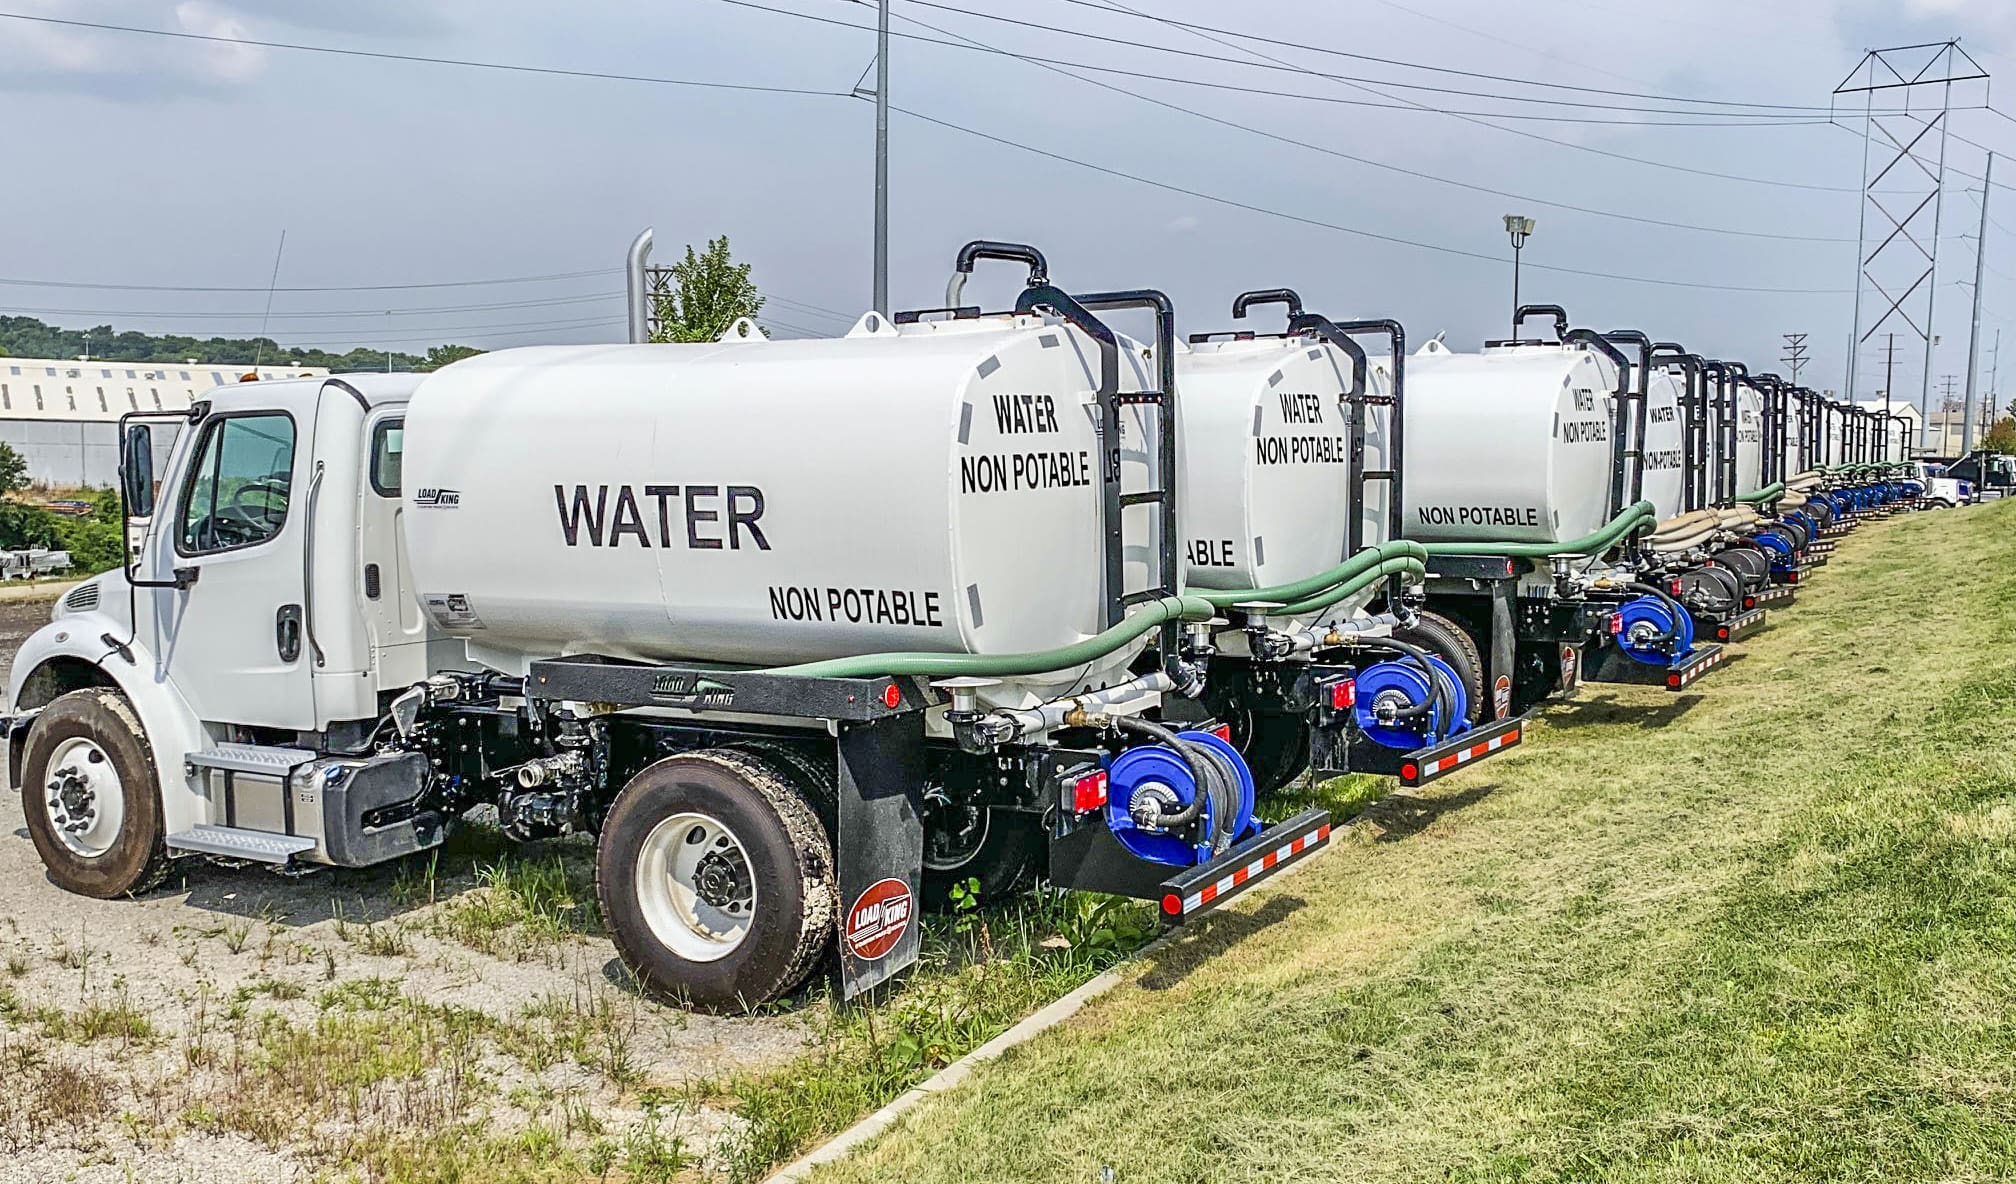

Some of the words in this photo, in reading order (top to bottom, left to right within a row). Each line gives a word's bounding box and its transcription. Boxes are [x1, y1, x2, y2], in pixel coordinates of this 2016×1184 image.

[993, 395, 1059, 434] WATER
[1280, 393, 1323, 424] WATER
[1572, 388, 1595, 412] WATER
[1649, 406, 1675, 424] WATER
[1563, 421, 1580, 444] NON
[1580, 420, 1606, 442] POTABLE
[1256, 436, 1288, 465] NON
[1291, 436, 1344, 464] POTABLE
[961, 454, 1007, 494] NON
[1013, 451, 1090, 490] POTABLE
[418, 488, 437, 498] LOAD
[440, 494, 459, 504] KING
[554, 484, 772, 551] WATER
[1418, 506, 1455, 525] NON
[1459, 506, 1538, 526] POTABLE
[769, 586, 822, 621] NON
[827, 588, 943, 627] POTABLE
[854, 903, 881, 931] LOAD
[883, 900, 908, 927] KING
